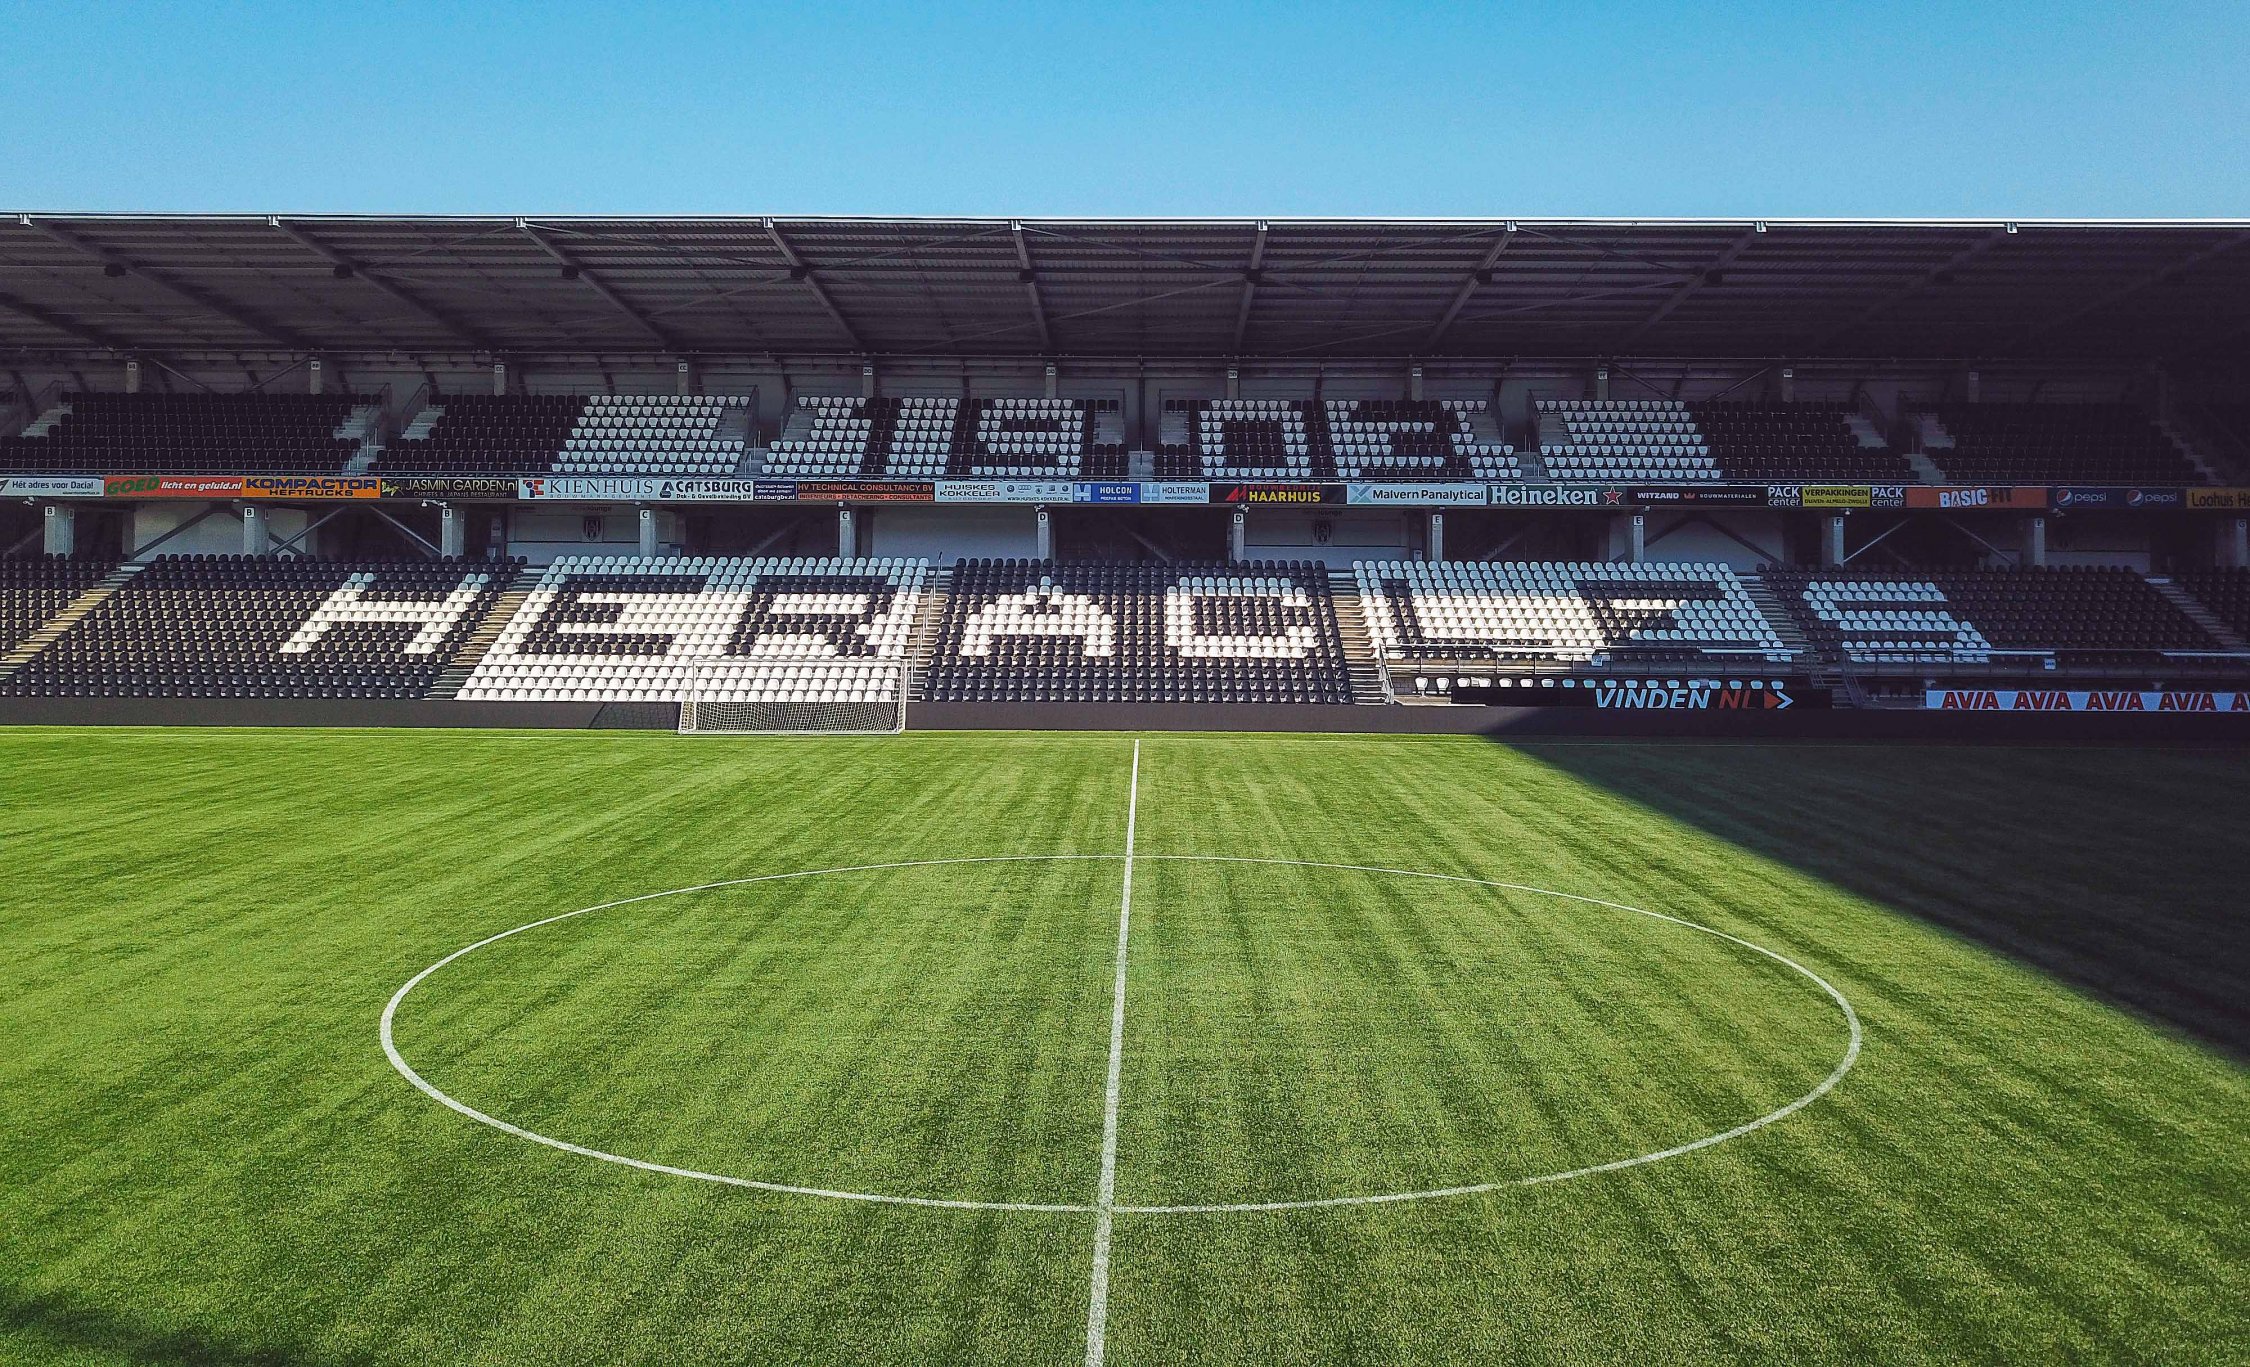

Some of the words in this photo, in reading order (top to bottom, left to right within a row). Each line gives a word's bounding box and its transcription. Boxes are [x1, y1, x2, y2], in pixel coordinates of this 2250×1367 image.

[28, 480, 49, 489] adres
[71, 480, 94, 489] Dacia!
[161, 481, 182, 489] licht
[198, 481, 242, 491] geluid.nl
[246, 479, 377, 489] KOMPACTOR
[406, 480, 450, 491] JASMIN
[452, 480, 518, 491] GARDEN.nl
[550, 479, 653, 494] KIENHUIS
[676, 481, 751, 493] CATSBURG
[270, 489, 353, 497] HEFTRUCKS
[1100, 486, 1132, 495] HOLCON
[1162, 486, 1206, 495] HOLTERMAN
[1372, 489, 1419, 499] Malvern
[1421, 489, 1484, 502] Panalytical
[1490, 485, 1598, 505] Heineken
[1767, 486, 1800, 498] PACK
[1804, 489, 1868, 497] VERPAKKINGEN
[1871, 487, 1904, 498] PACK
[1249, 491, 1321, 503] HAARHUIS
[2074, 493, 2107, 502] pepsi
[2144, 492, 2177, 502] pepsi
[1767, 498, 1800, 507] center
[1871, 498, 1904, 507] center
[1595, 688, 1711, 709] VINDEN
[1942, 692, 1999, 709] AVIA
[2013, 692, 2071, 709] AVIA
[2085, 692, 2144, 710] AVIA
[2158, 692, 2216, 710] AVIA
